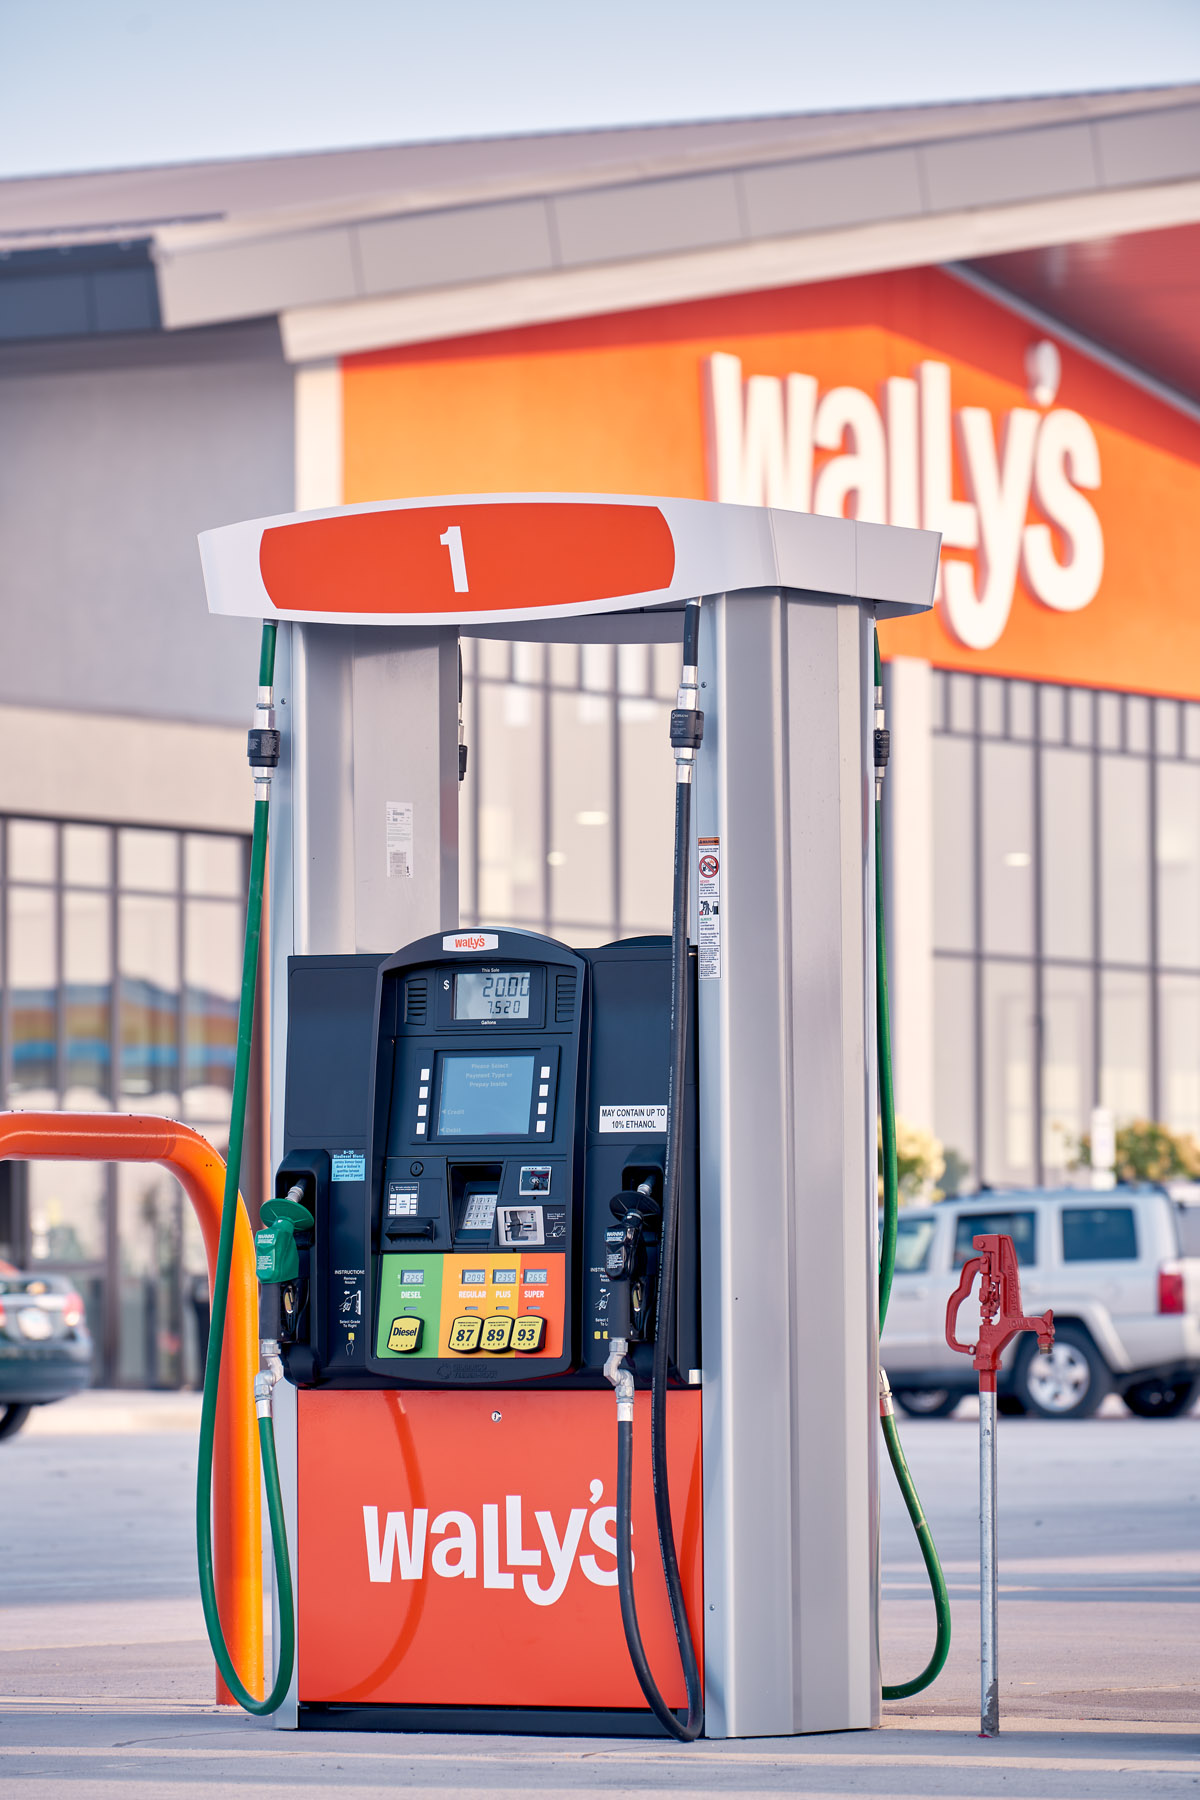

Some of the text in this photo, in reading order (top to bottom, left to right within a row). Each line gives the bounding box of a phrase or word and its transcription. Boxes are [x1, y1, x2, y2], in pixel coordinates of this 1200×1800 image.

[440, 526, 469, 592] 1
[444, 980, 450, 990] $
[483, 977, 530, 998] 20.00
[488, 1000, 520, 1014] 7.520
[393, 1327, 535, 1342] Diesel 87 89 93
